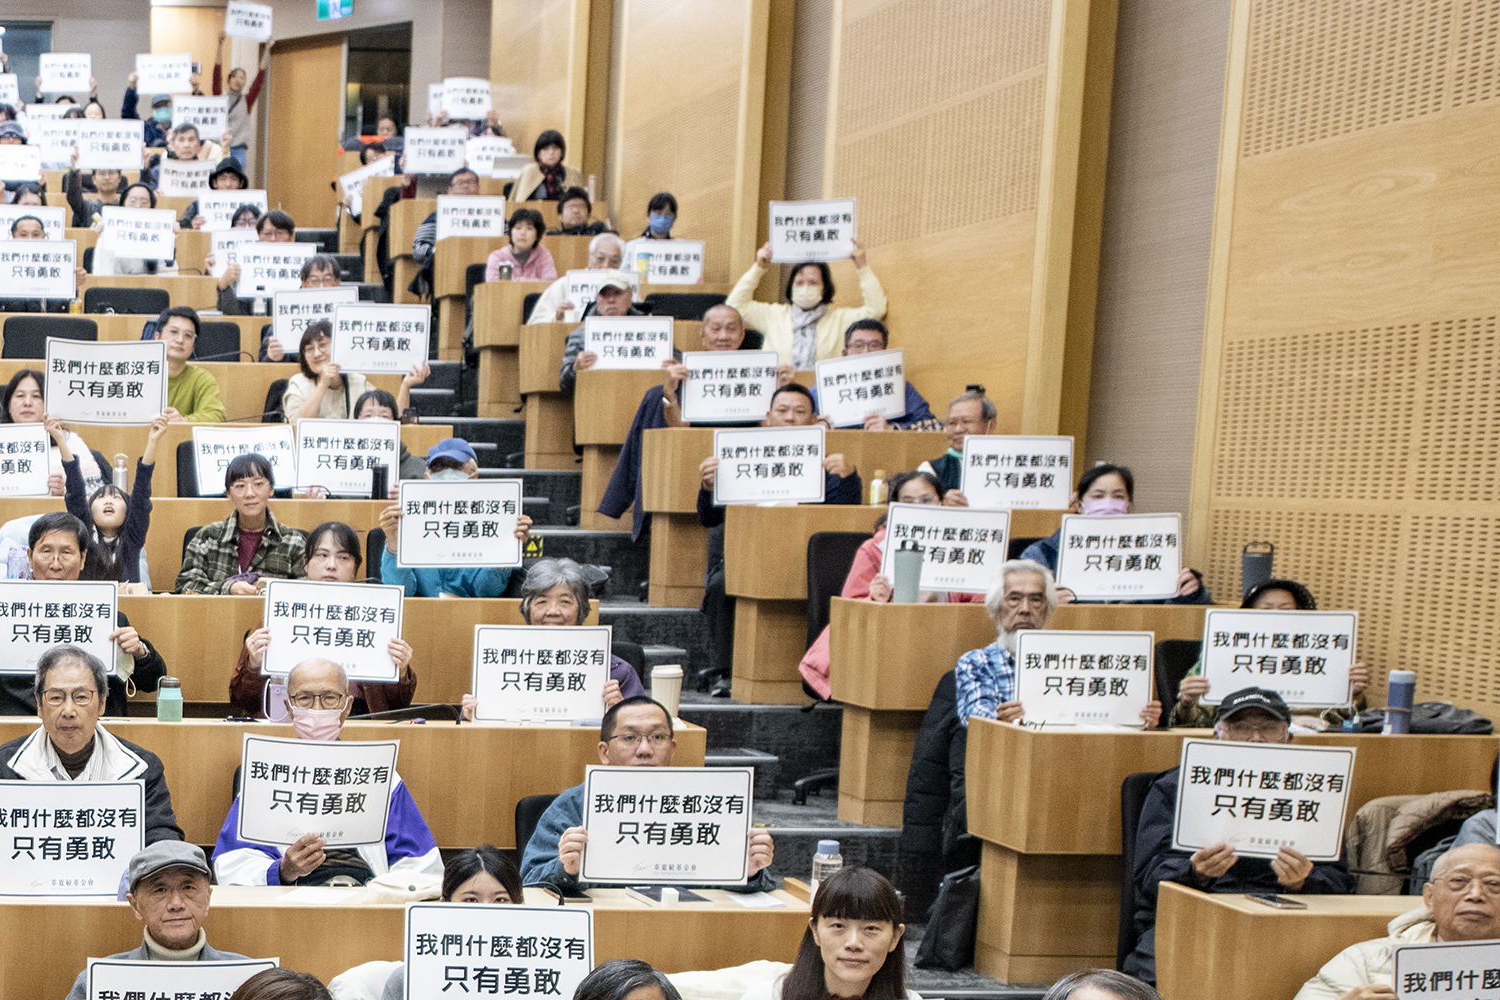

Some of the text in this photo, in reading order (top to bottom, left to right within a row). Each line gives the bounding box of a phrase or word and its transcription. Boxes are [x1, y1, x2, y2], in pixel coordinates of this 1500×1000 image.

[274, 602, 395, 623] 我們什麼都沒有
[12, 624, 92, 643] 只有勇敢
[291, 625, 375, 648] 只有勇敢
[1214, 632, 1348, 650] 我們什麼都沒有
[483, 648, 604, 665] 我們什麼都沒有
[1026, 654, 1147, 671] 我們什麼都沒有
[1232, 655, 1326, 675] 只有勇敢
[501, 672, 586, 691] 只有勇敢
[1044, 677, 1128, 696] 只有勇敢
[251, 762, 389, 785] 我們什麼都沒有
[1191, 766, 1344, 793] 我們什麼都沒有
[270, 790, 367, 815] 只有勇敢
[595, 794, 744, 814] 我們什麼都沒有
[1211, 795, 1320, 822] 只有勇敢
[616, 822, 720, 845] 只有勇敢
[11, 836, 115, 860] 只有勇敢
[416, 934, 584, 960] 我們什麼都沒有
[442, 966, 561, 995] 只有勇敢
